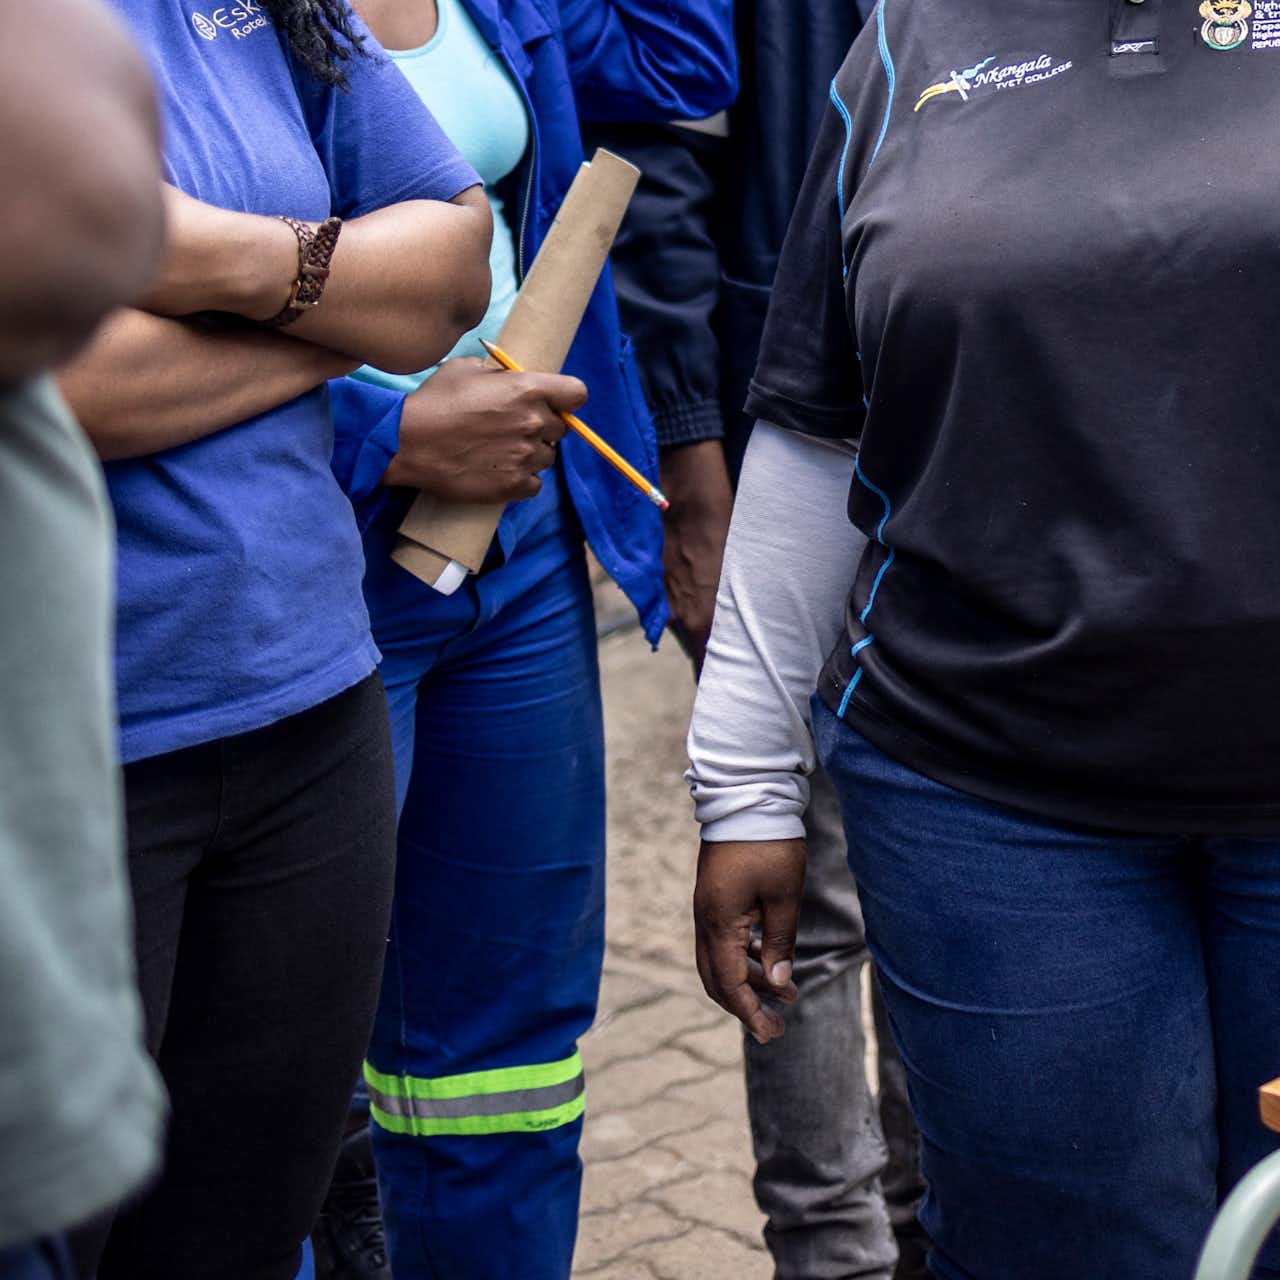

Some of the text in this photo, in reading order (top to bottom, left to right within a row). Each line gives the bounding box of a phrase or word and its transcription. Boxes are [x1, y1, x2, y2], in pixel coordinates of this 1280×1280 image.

[1254, 9, 1265, 20] &
[972, 54, 1053, 89] Nkangala
[995, 60, 1074, 91] TVET COLLEGE
